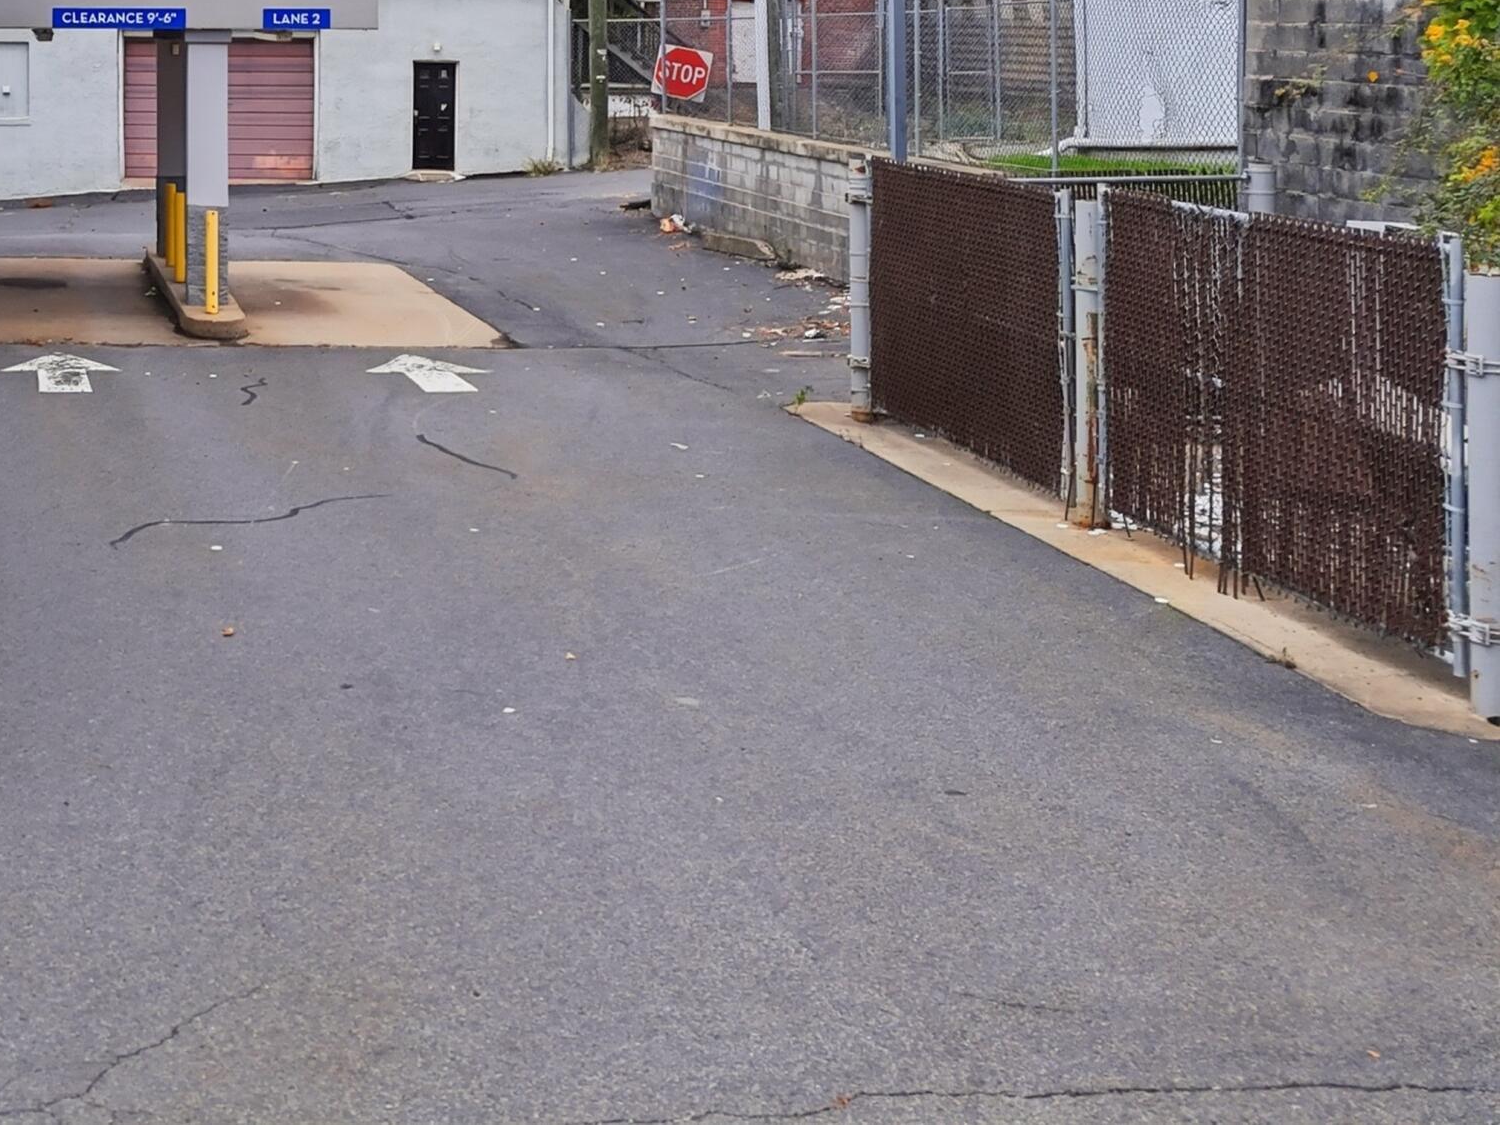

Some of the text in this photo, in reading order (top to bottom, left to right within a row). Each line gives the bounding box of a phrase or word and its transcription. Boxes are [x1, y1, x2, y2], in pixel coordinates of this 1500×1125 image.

[61, 12, 143, 24] CLEARANCE
[273, 13, 320, 24] LANE 2
